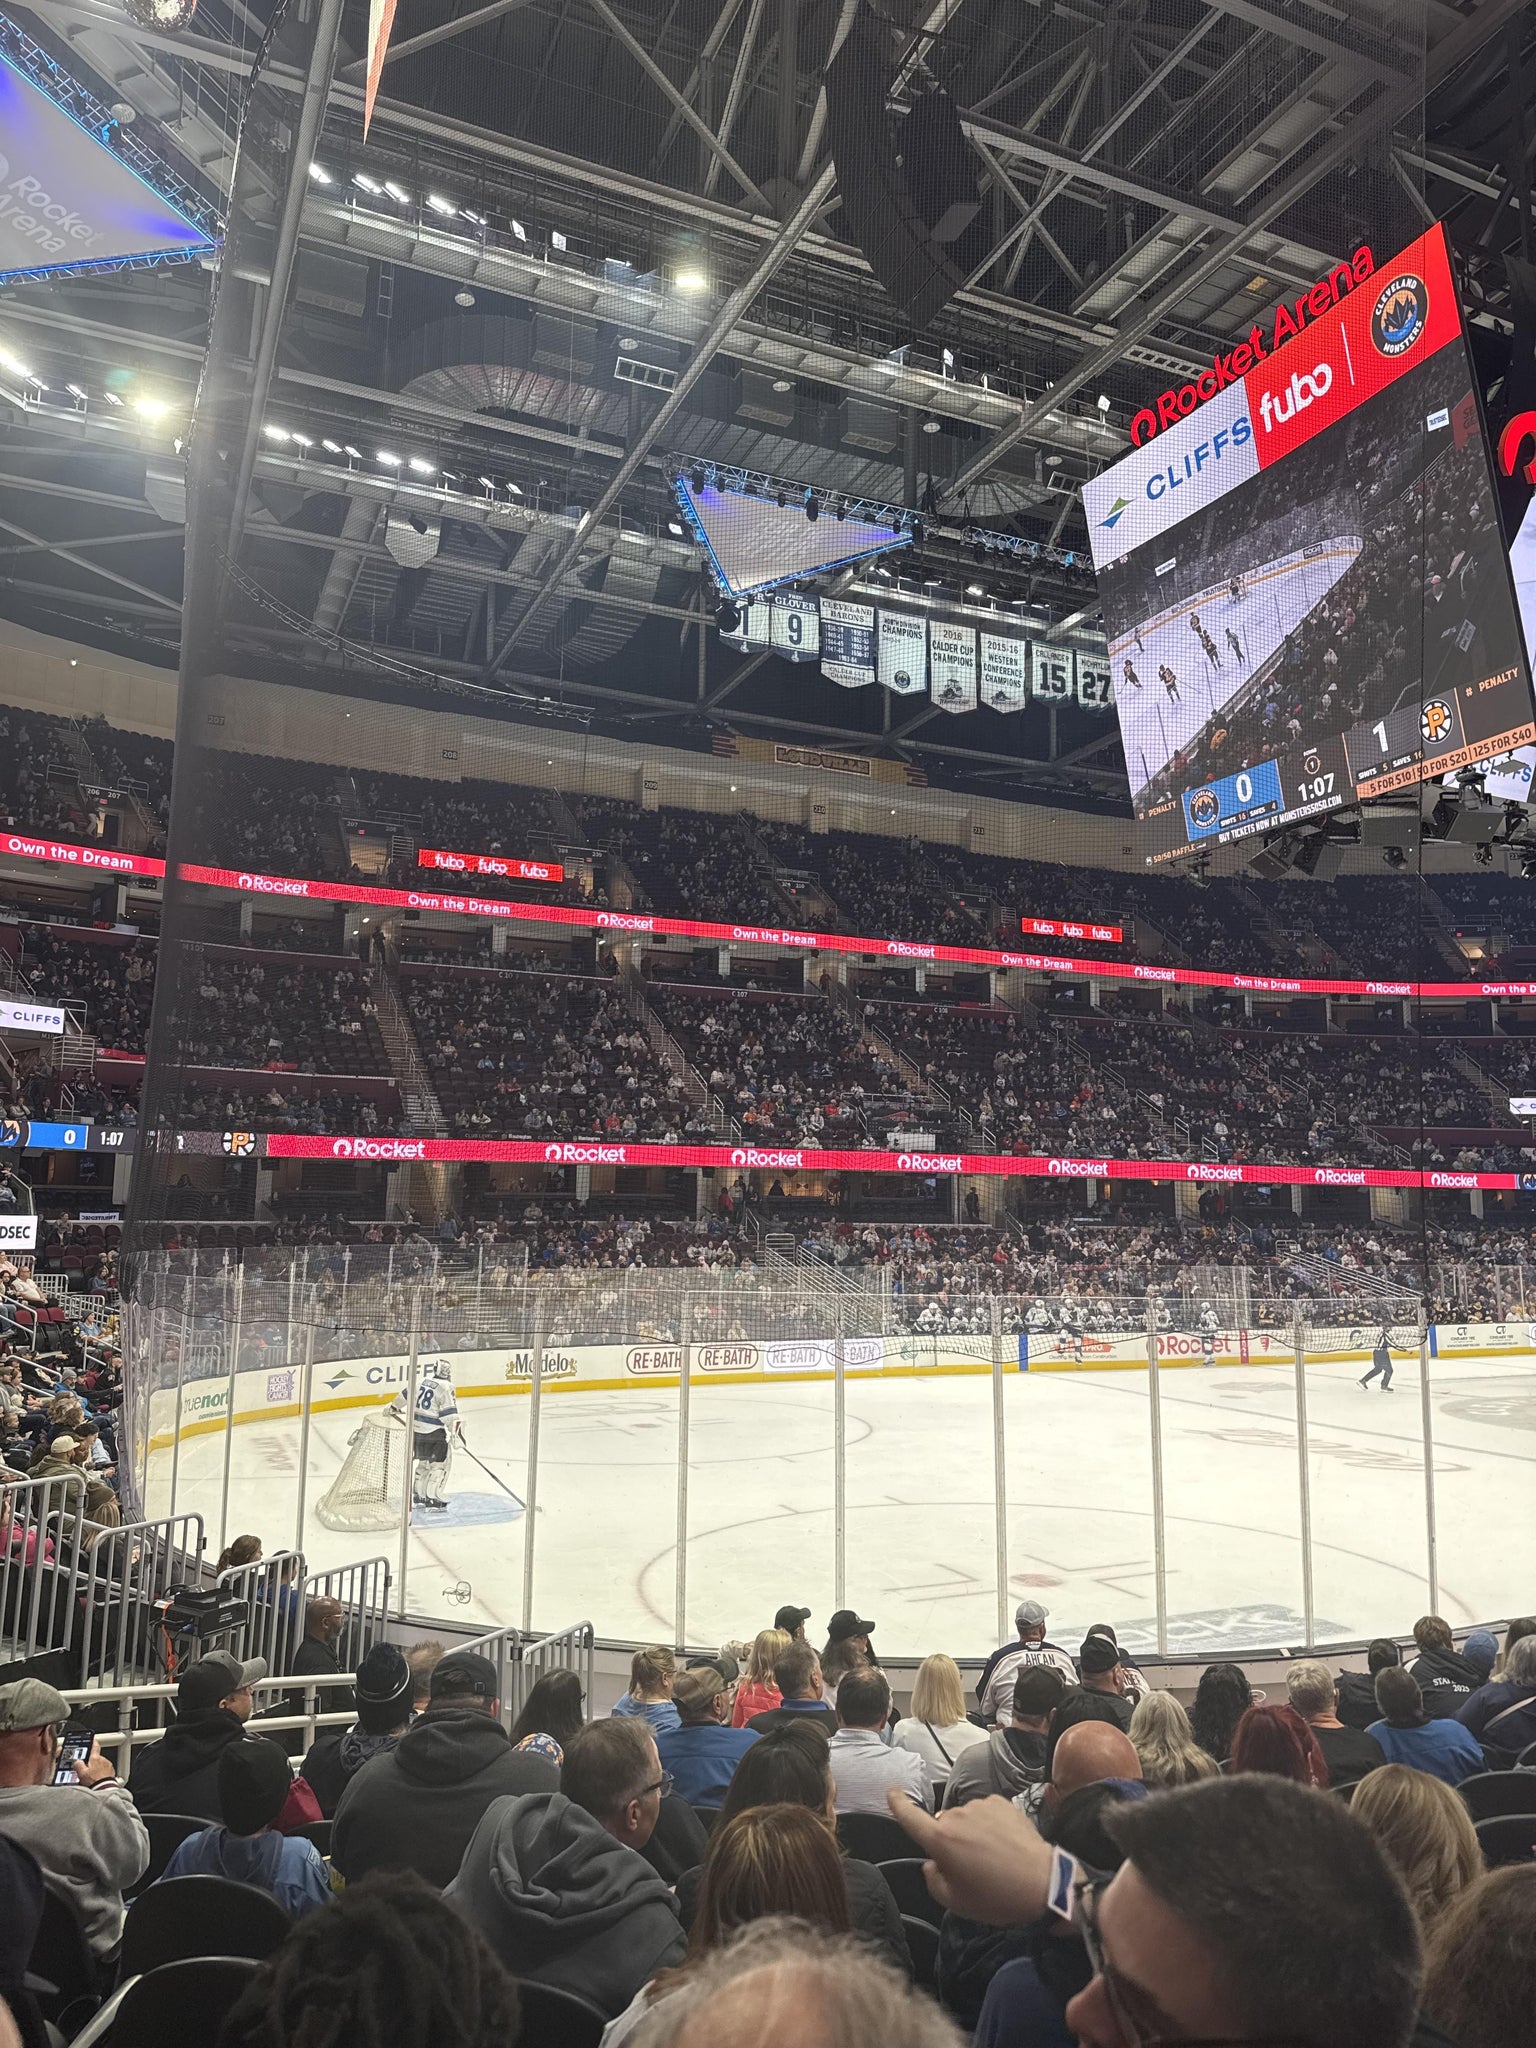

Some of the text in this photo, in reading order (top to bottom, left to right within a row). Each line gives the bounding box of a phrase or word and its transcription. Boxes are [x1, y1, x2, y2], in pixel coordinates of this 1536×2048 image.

[8, 175, 105, 248] Rocket
[1375, 278, 1417, 316] CLEVELAND
[1156, 245, 1375, 431] Rocket Arena
[1383, 320, 1422, 354] MONSTERS
[1259, 363, 1332, 433] fubo
[1146, 416, 1251, 500] CLIFFS
[775, 596, 816, 611] GLOVER
[822, 600, 873, 616] CLEVELAND
[830, 610, 865, 623] BARONS
[788, 613, 802, 646] 9
[882, 624, 922, 640] CHAMPIONS
[943, 629, 963, 640] 2016
[932, 640, 974, 656] CALDER CUP
[987, 641, 1019, 655] 2015-16
[933, 652, 974, 668] CHAMPIONS
[988, 653, 1018, 667] WESTERN
[983, 662, 1022, 678] CONFERENCE
[1040, 661, 1066, 694] 15
[985, 673, 1022, 688] CHAMPIONS
[1082, 671, 1111, 703] 27
[1478, 667, 1519, 692] PENALTY
[1426, 706, 1445, 737] P
[1372, 721, 1388, 752] 1
[1370, 728, 1532, 793] 5 FOR $10 50 FOR $20 125 FOR $40
[1392, 754, 1412, 768] SAVES
[1235, 773, 1253, 803] 0
[1298, 772, 1335, 802] 1:07
[1148, 801, 1177, 817] PENALTY
[1218, 832, 1230, 843] BUY
[1231, 823, 1255, 839] TICKETS
[1256, 818, 1270, 831] NOW
[1271, 815, 1278, 826] AT
[8, 838, 133, 869] Own the Dream
[1153, 852, 1171, 863] 50/50
[1172, 844, 1196, 858] RAFFLE
[434, 853, 549, 878] fubo fubo fubo
[254, 875, 309, 895] Rocket
[408, 893, 511, 915] Own the Dream
[609, 915, 654, 930] Rocket
[1033, 921, 1112, 940] fubo fubo fubo
[733, 927, 817, 945] Own the Dream
[897, 943, 935, 957] Rocket
[1001, 954, 1073, 970] Own the Dream
[1143, 967, 1176, 980] Rocket
[1233, 976, 1301, 991] Own the Dream
[1375, 982, 1411, 994] Rocket
[1482, 984, 1506, 994] Own
[1508, 984, 1526, 993] the
[13, 1011, 61, 1025] CLIFFS
[64, 1130, 76, 1145] 0
[100, 1131, 124, 1146] 1:07
[353, 1139, 425, 1159] Rocket
[563, 1145, 626, 1162] Rocket
[748, 1149, 803, 1168] Rocket
[912, 1155, 962, 1172] Rocket
[1062, 1160, 1109, 1176] Rocket
[1200, 1165, 1243, 1180] Rocket
[1325, 1170, 1366, 1184] Rocket
[1441, 1174, 1479, 1187] Rocket
[1025, 1653, 1055, 1666] AHCAN
